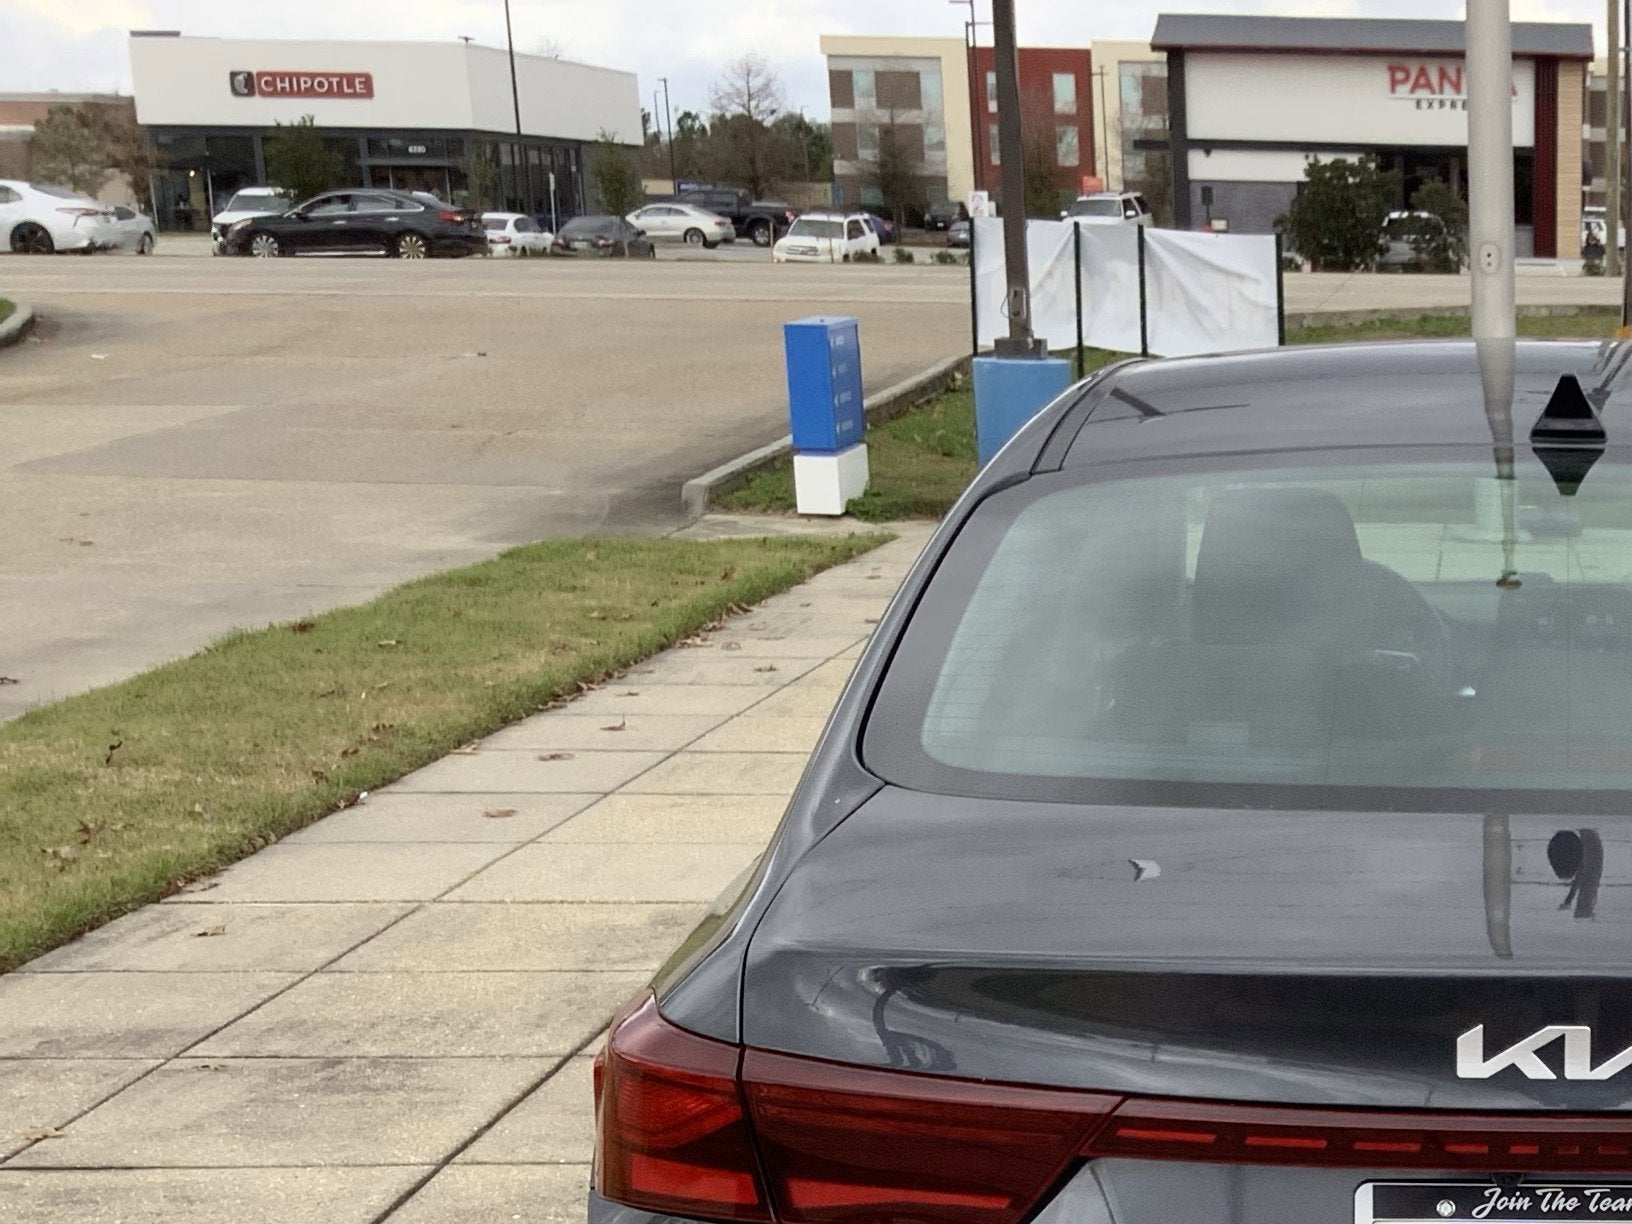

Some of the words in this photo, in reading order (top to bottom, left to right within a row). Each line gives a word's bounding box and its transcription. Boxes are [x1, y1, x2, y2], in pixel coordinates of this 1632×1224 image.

[260, 76, 367, 93] CHIPOTLE
[1387, 64, 1518, 97] PAN
[1415, 99, 1467, 110] EXPRE
[1471, 1187, 1532, 1219] Join
[1535, 1188, 1581, 1213] The
